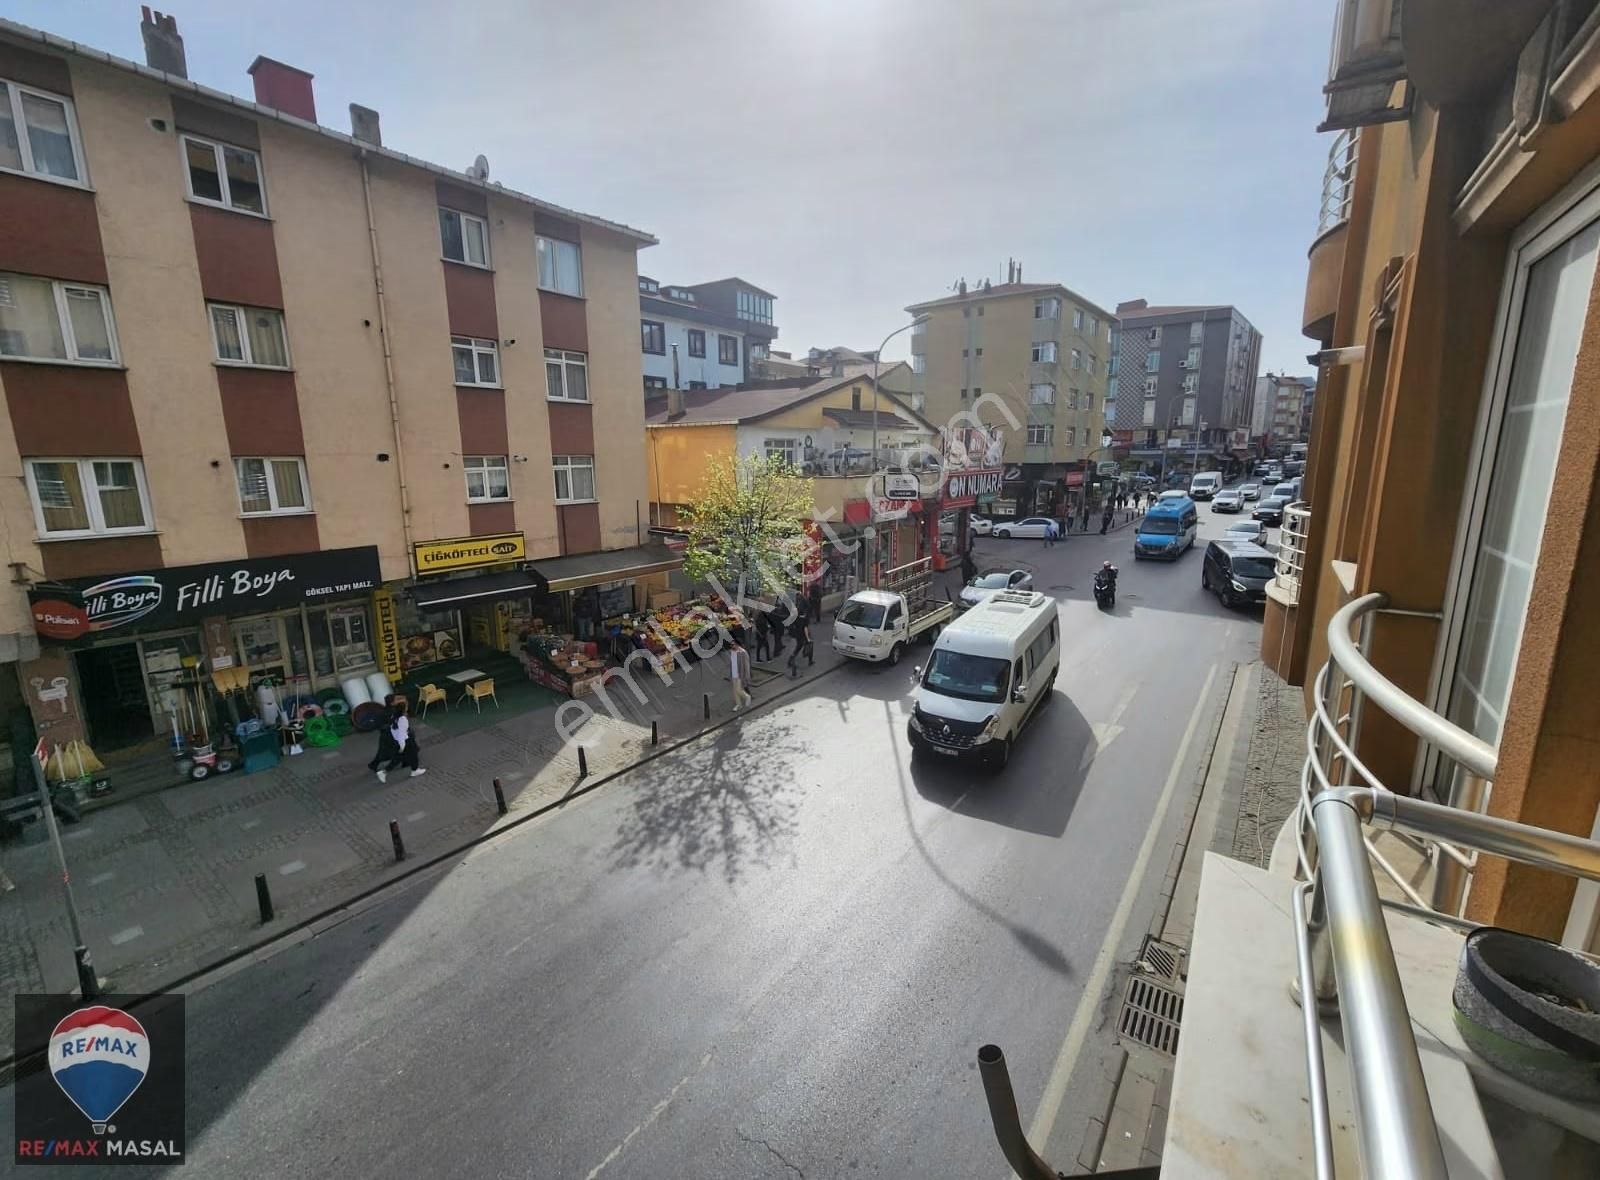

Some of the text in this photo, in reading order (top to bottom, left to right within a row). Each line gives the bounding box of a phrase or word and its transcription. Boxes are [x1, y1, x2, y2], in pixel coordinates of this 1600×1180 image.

[949, 475, 965, 498] ON
[967, 473, 1003, 497] NUMARA
[176, 567, 296, 612] Filli Boya
[305, 586, 334, 597] GÖKSEL
[334, 583, 351, 593] YAPI
[84, 591, 159, 616] illi Boya
[45, 614, 80, 625] Polisan
